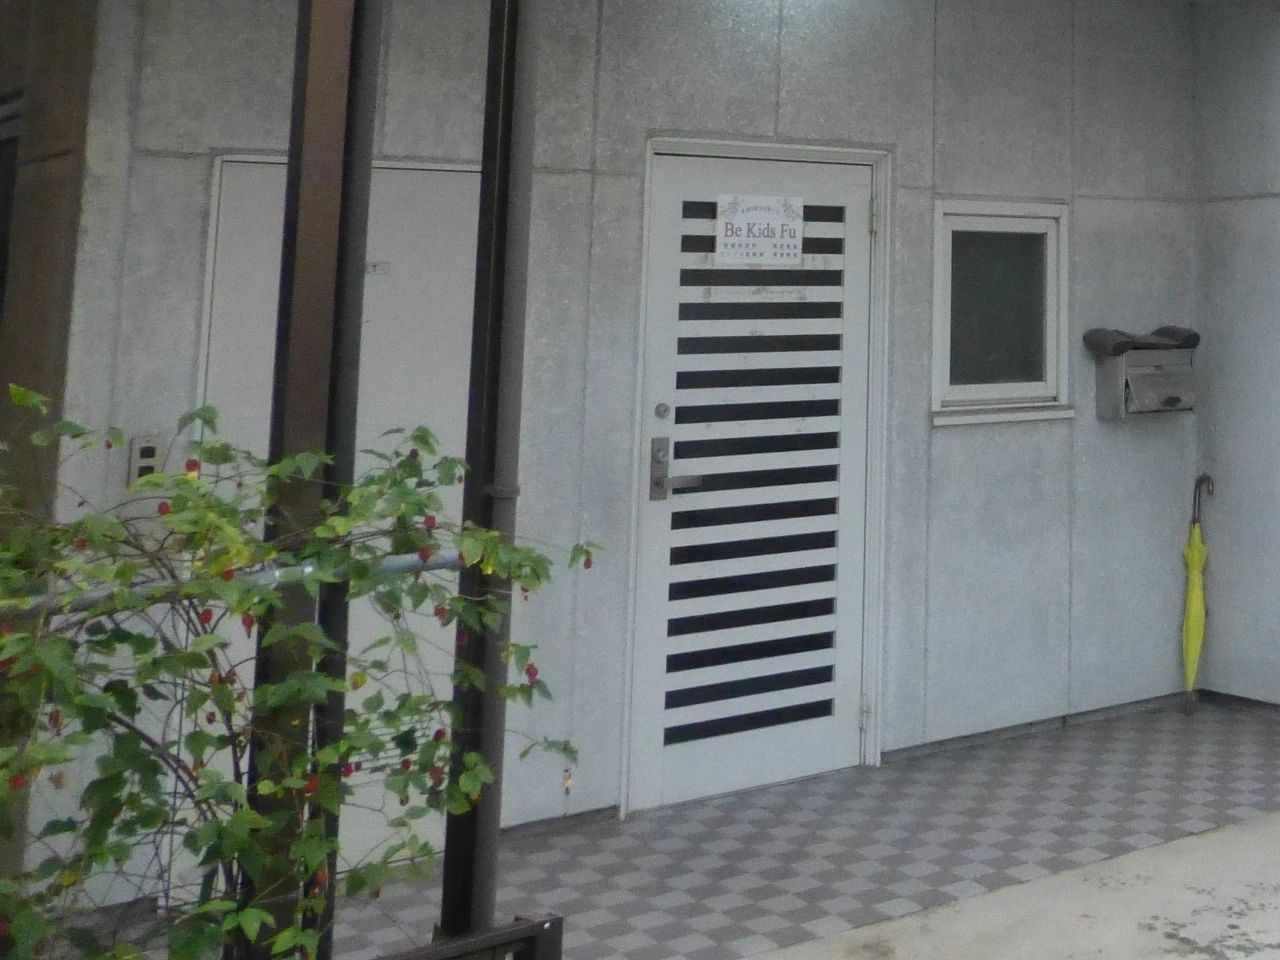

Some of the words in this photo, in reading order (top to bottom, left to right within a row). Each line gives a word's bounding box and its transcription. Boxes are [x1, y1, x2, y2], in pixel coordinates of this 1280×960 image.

[724, 222, 742, 238] Be
[746, 222, 776, 239] Kids
[780, 223, 797, 239] Fu
